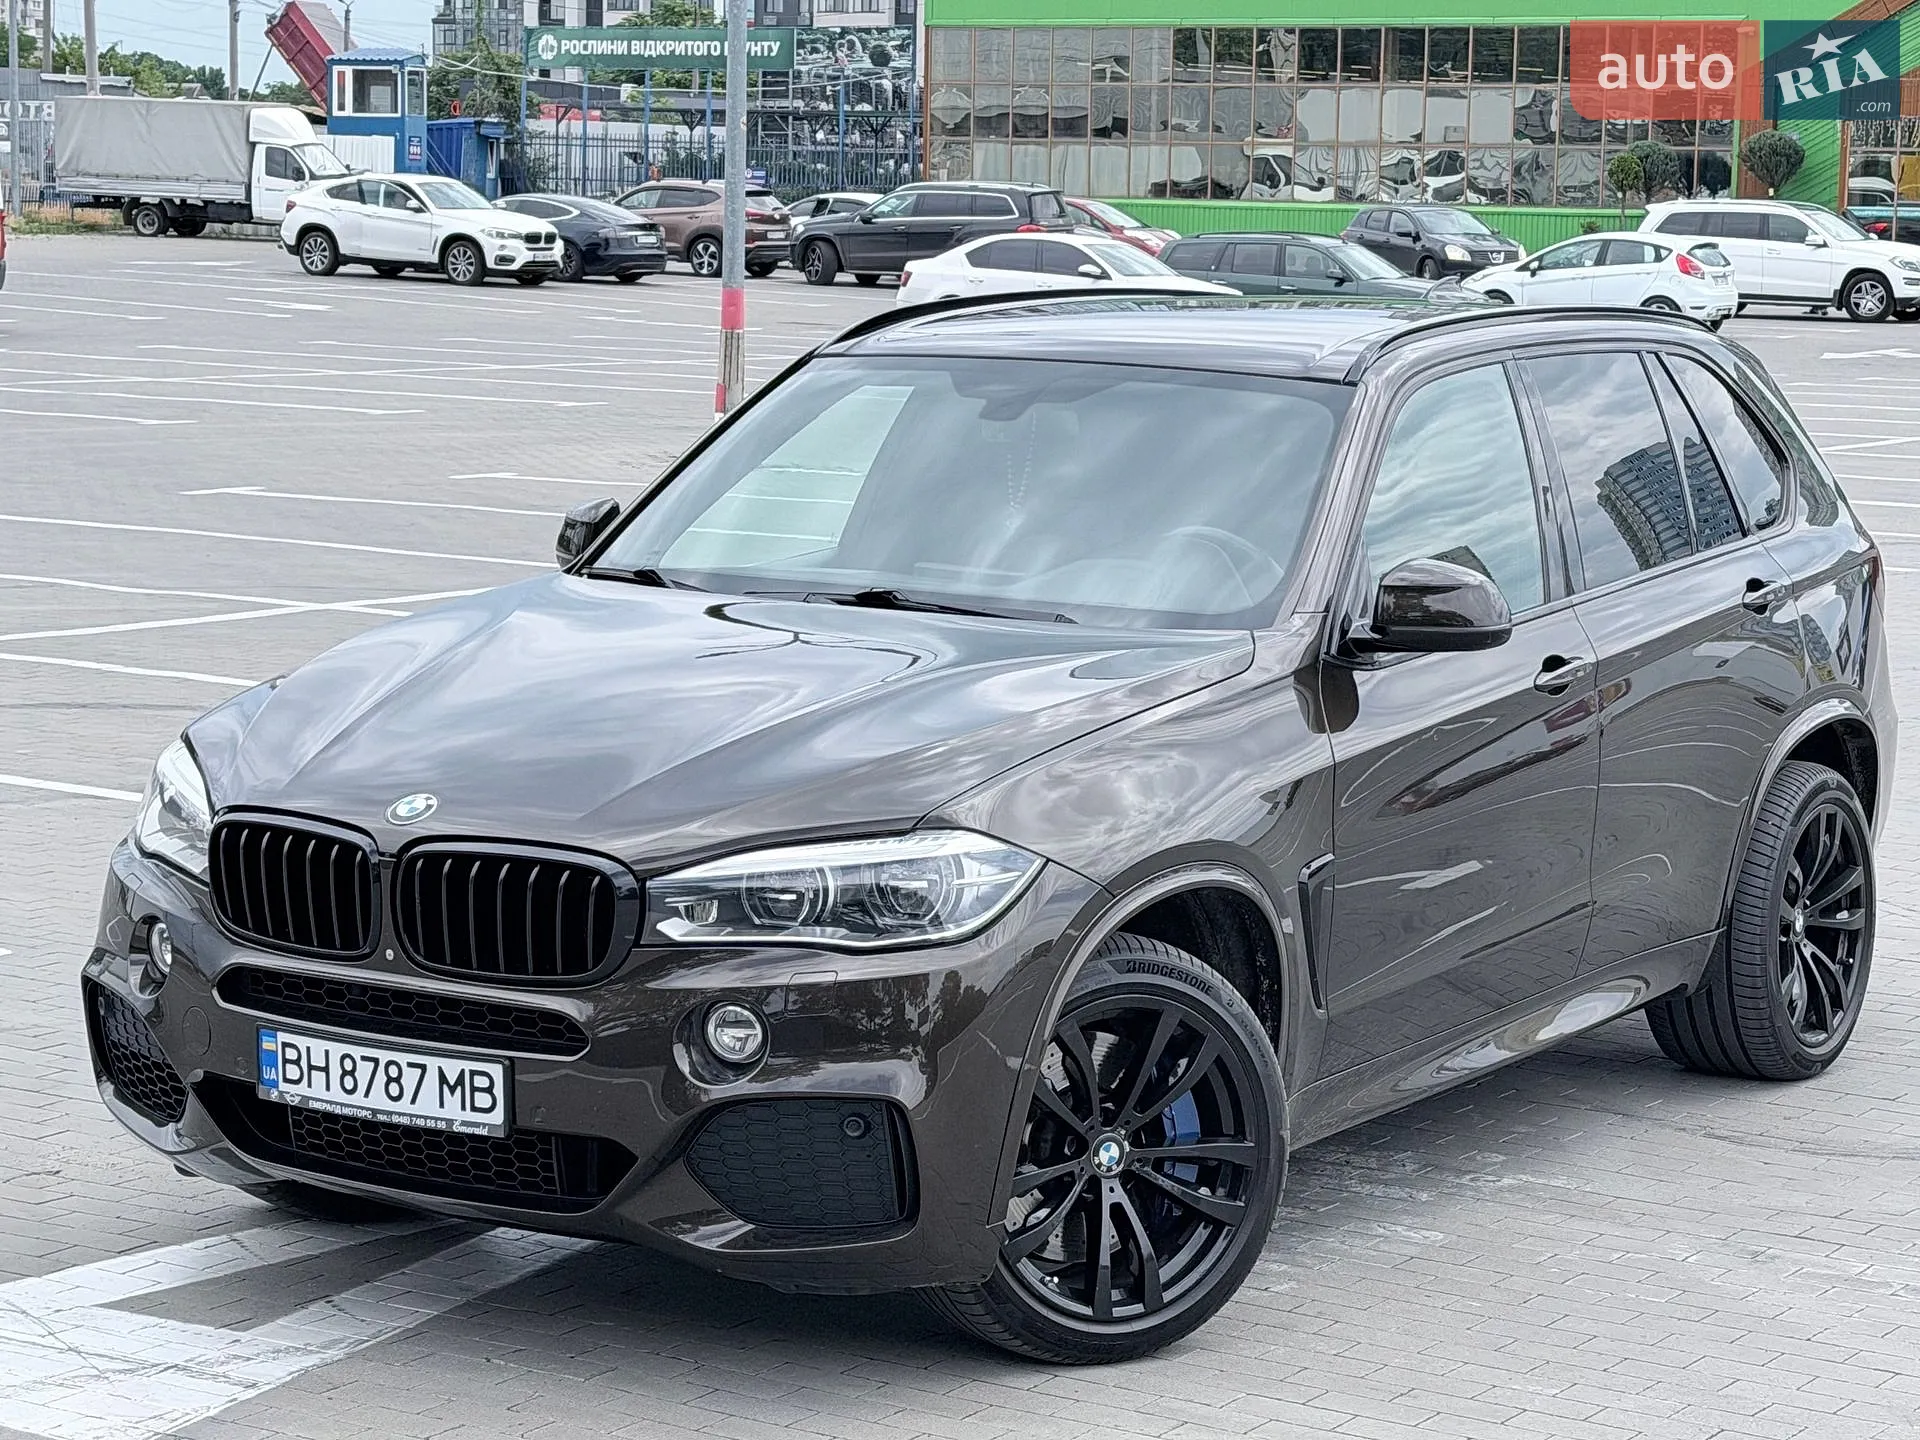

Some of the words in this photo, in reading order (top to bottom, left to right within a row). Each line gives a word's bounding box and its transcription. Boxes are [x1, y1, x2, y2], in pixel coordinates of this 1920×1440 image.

[561, 39, 628, 56] РОСЛИНИ
[631, 39, 721, 58] ВІДКРИТОГО
[724, 40, 781, 57] НТУ
[1126, 960, 1214, 996] BRIDGESTONE
[262, 1065, 278, 1081] UA
[281, 1041, 331, 1093] BH
[339, 1052, 427, 1106] 8787
[437, 1065, 498, 1114] MB
[308, 1100, 341, 1114] ЕМЕРАЛД
[341, 1106, 373, 1119] МОТОРС
[426, 1119, 436, 1128] 55
[437, 1120, 447, 1129] 55
[452, 1119, 489, 1136] Emerald
